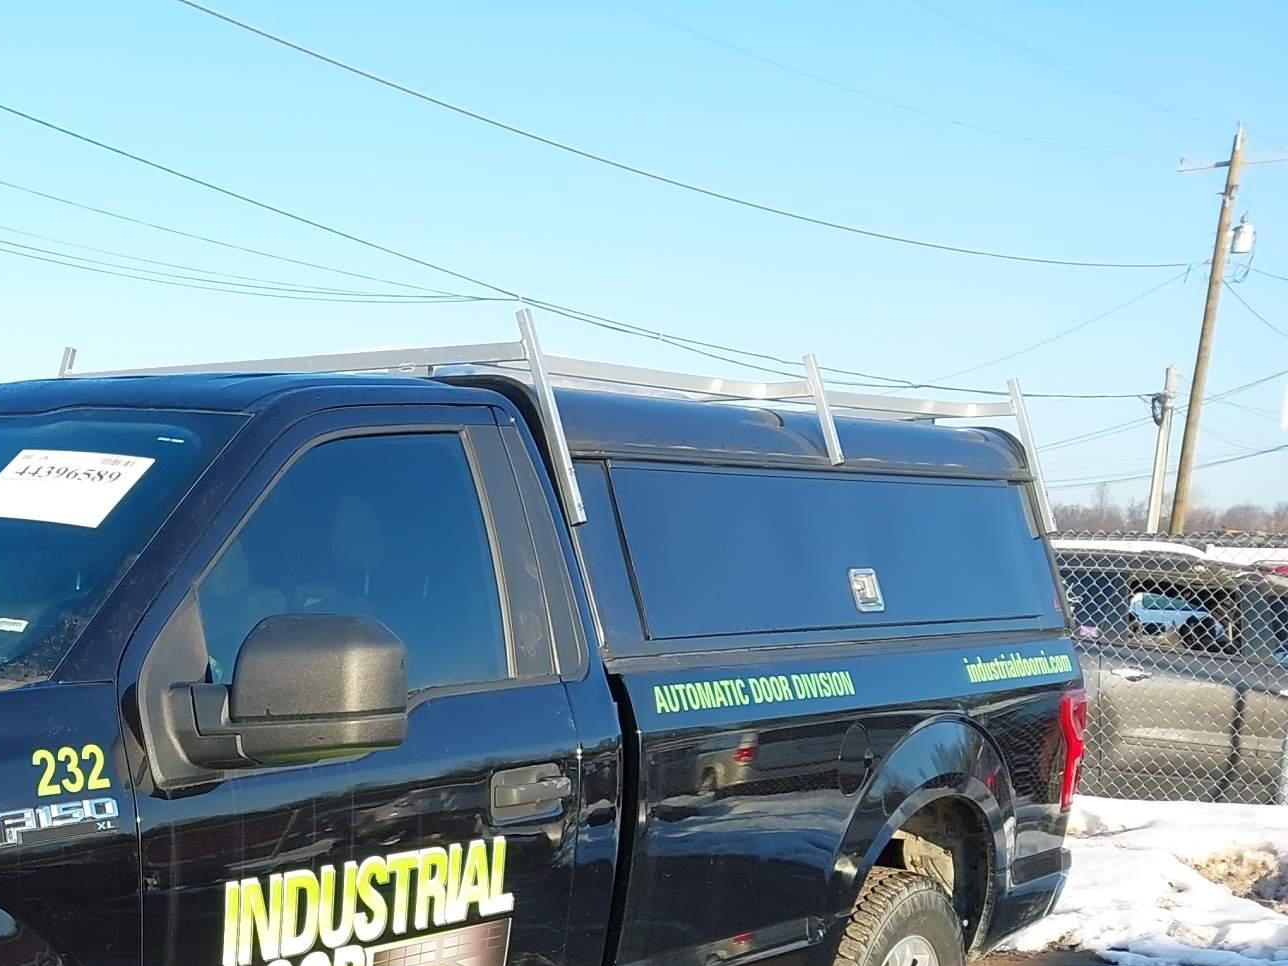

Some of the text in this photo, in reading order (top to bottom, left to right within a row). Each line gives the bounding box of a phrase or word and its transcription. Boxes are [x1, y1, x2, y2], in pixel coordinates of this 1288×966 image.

[964, 650, 1073, 683] industrialdoorni.com
[653, 670, 856, 714] AUTOMATIC DOOR DIVISION
[31, 744, 111, 797] 232
[96, 821, 116, 830] XL
